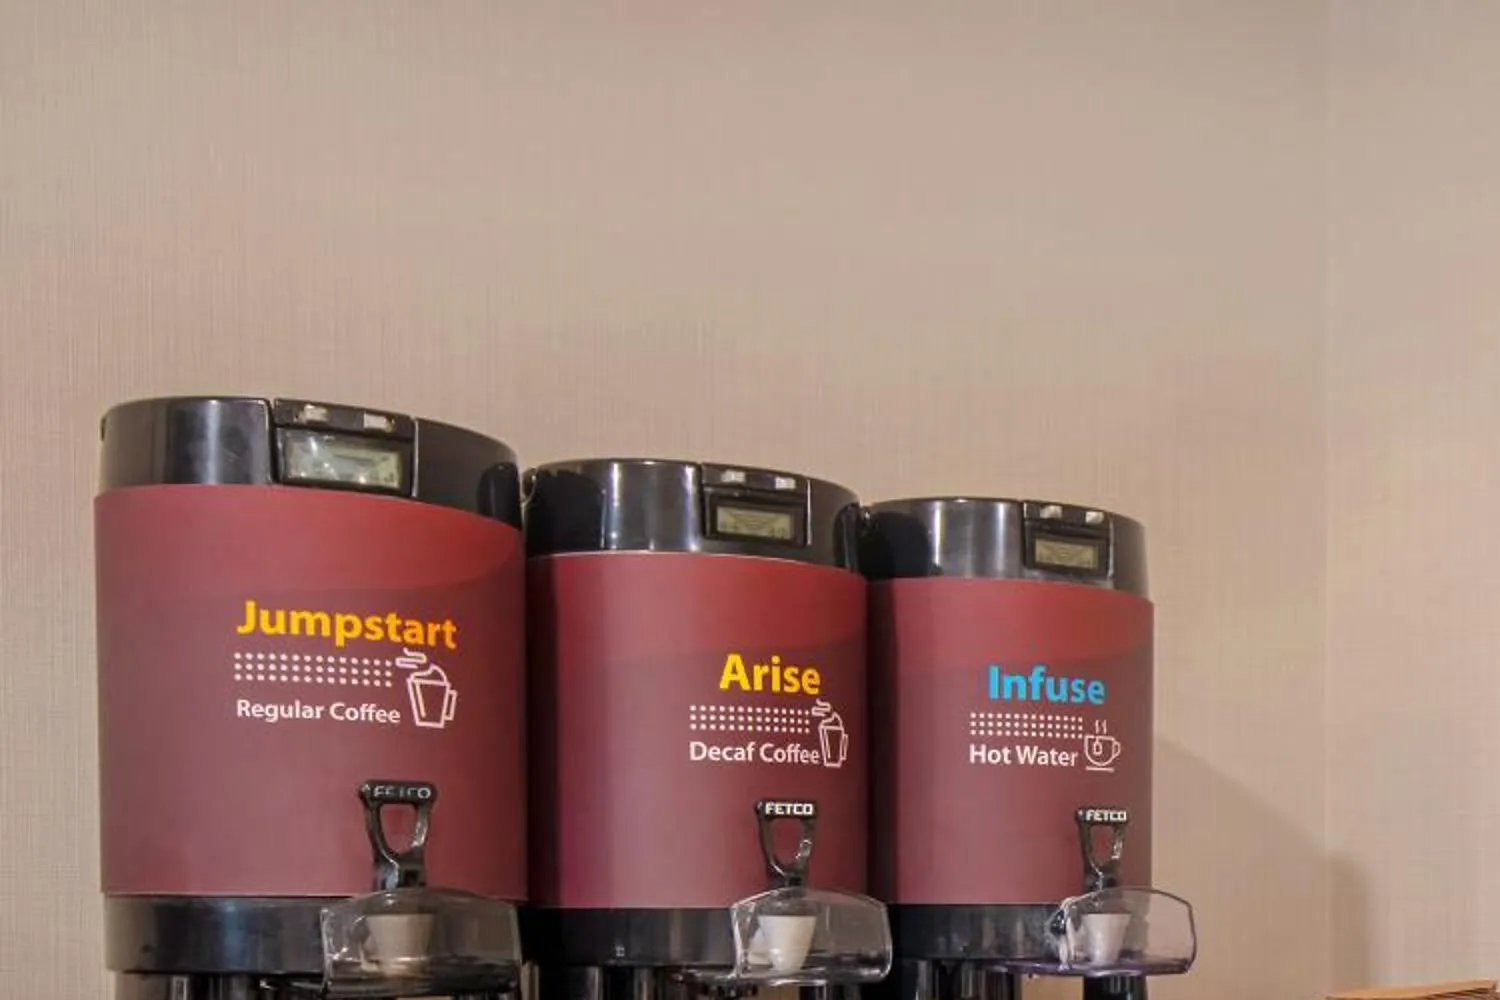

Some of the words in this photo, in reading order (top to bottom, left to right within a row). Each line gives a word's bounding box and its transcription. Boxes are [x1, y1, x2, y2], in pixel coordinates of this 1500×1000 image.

[236, 600, 458, 649] Jumpstart
[719, 653, 821, 695] Arise
[988, 665, 1105, 705] Infuse
[236, 699, 325, 723] Regular
[329, 702, 401, 724] Coffee
[689, 741, 756, 762] Decaf
[759, 743, 820, 765] Coffee
[969, 743, 1012, 764] Hot
[1015, 745, 1079, 767] Water
[764, 802, 813, 816] FETCO
[1085, 809, 1127, 821] FETCO
